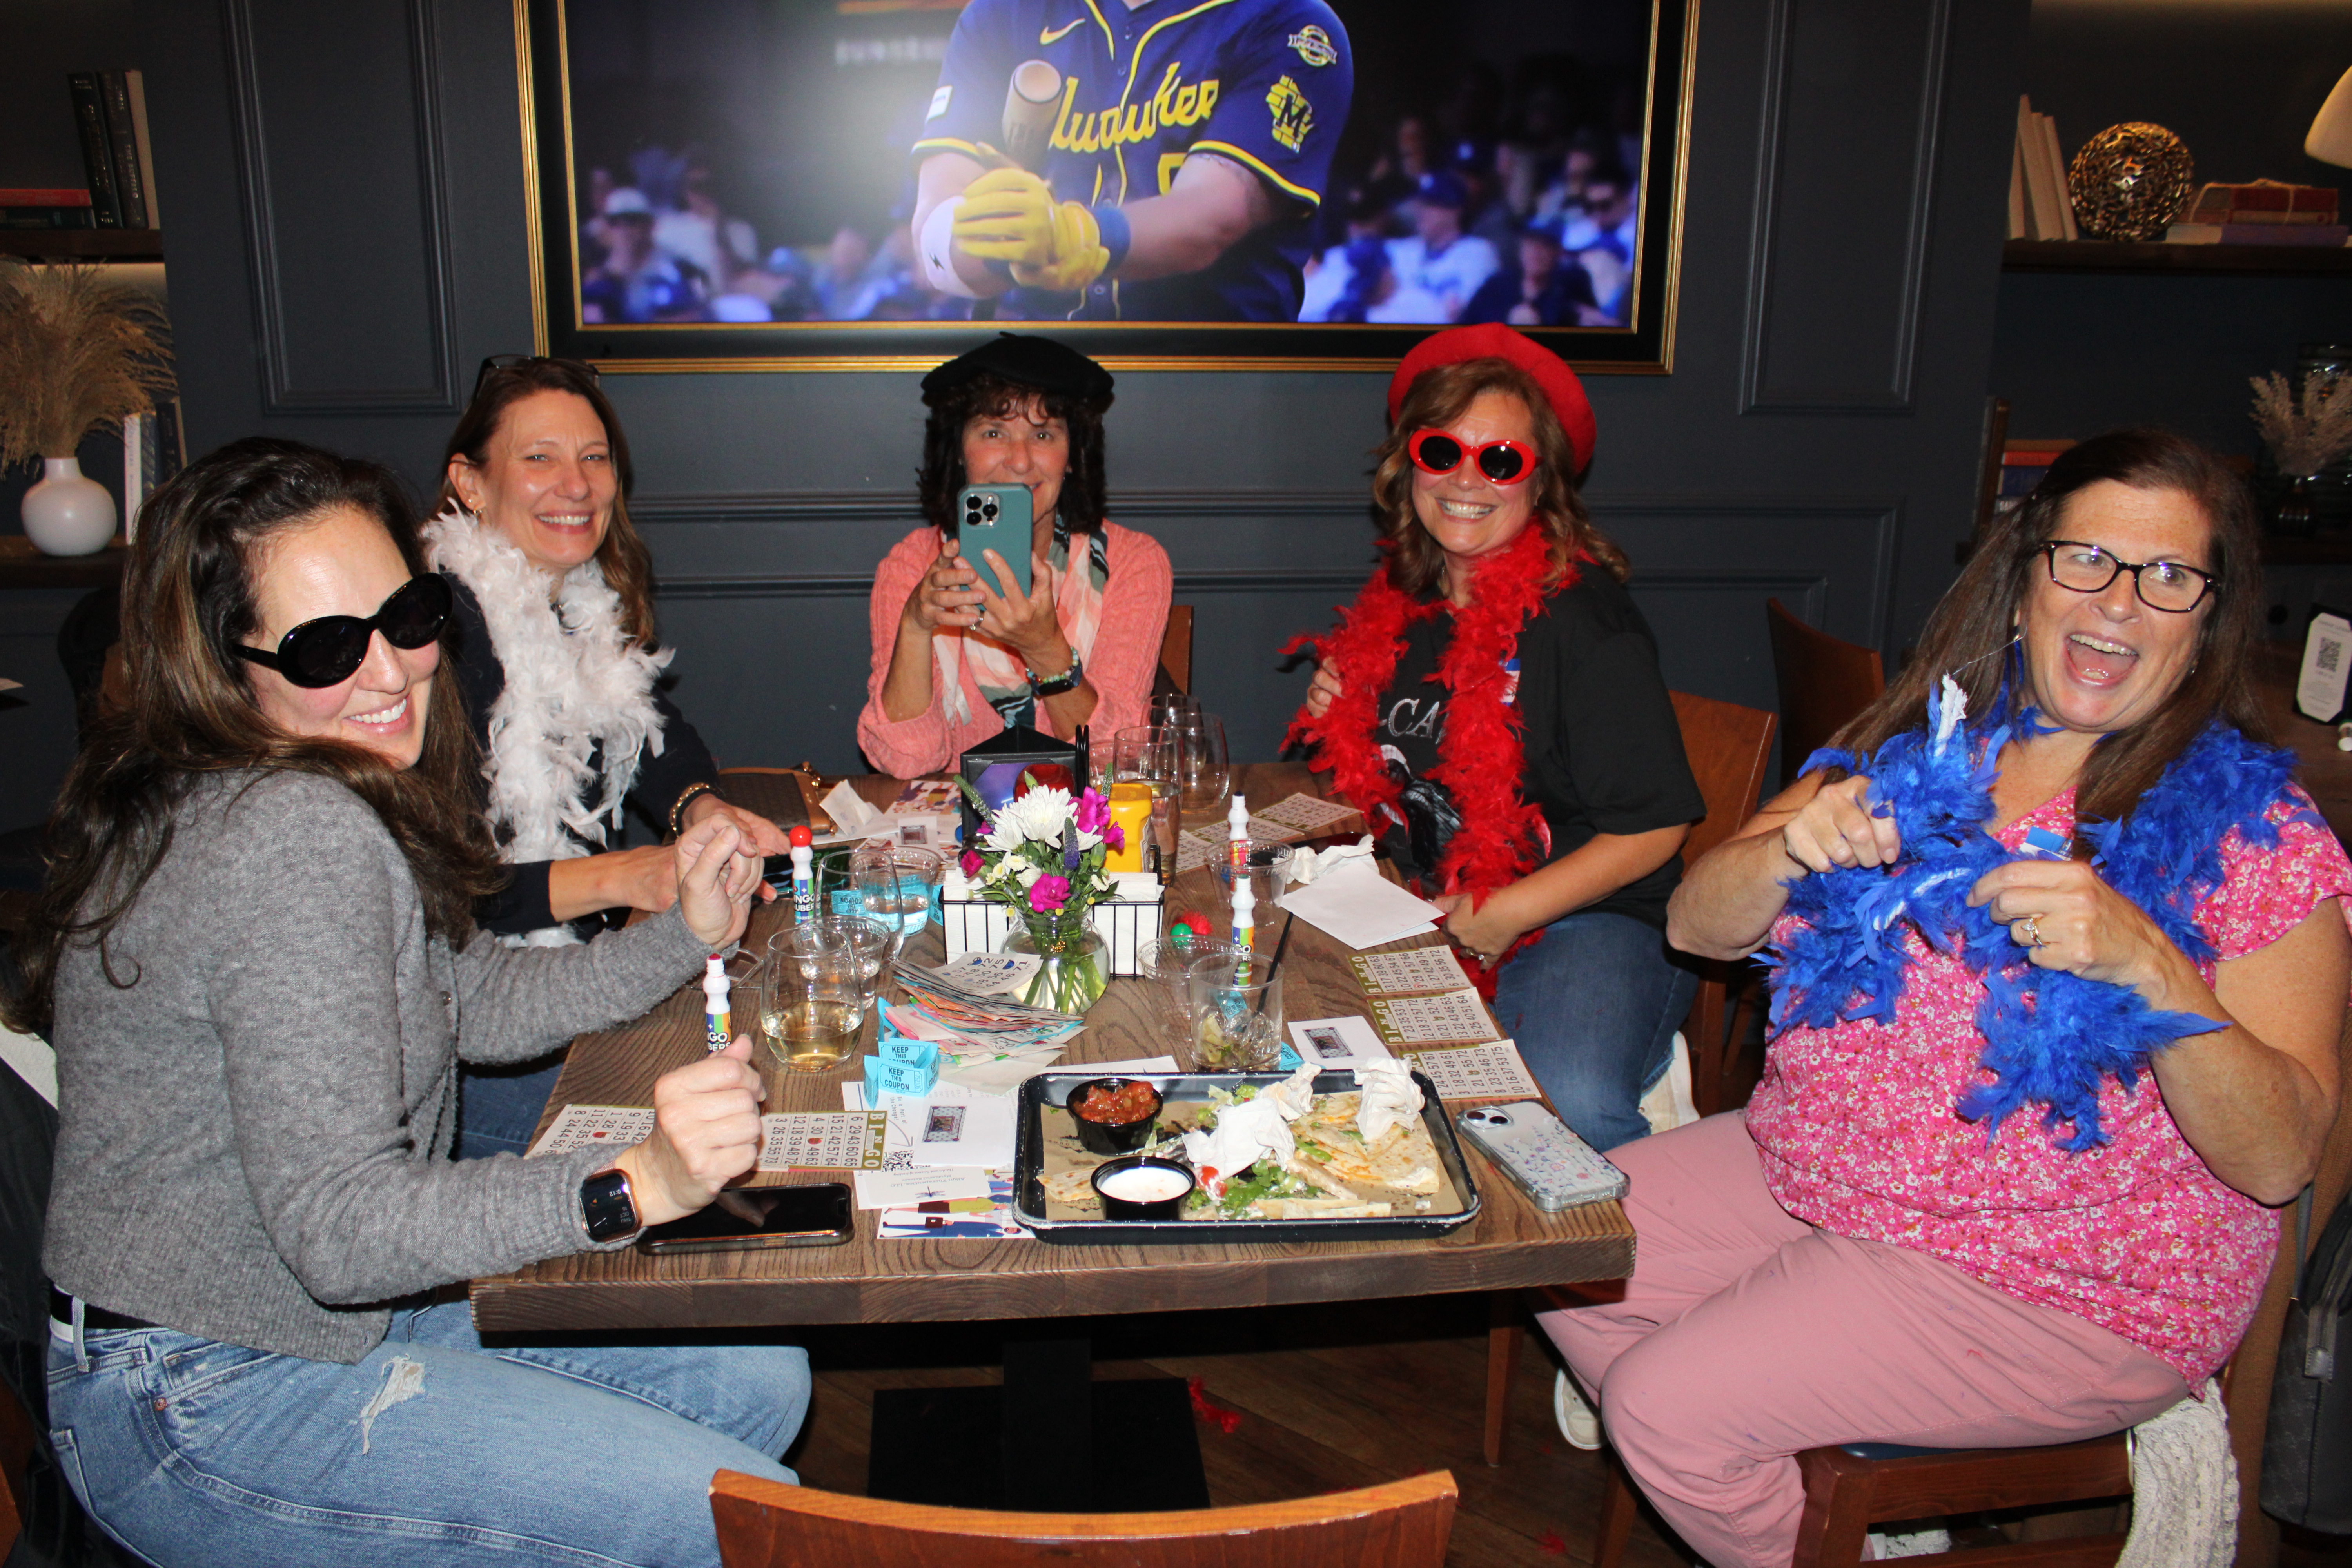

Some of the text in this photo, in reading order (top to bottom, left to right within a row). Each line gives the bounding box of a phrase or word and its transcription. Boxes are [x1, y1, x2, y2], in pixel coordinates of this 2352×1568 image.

[1049, 62, 1219, 153] lwaukee
[978, 958, 994, 968] 72
[990, 959, 1004, 969] 75
[1013, 960, 1028, 971] 71
[1456, 995, 1468, 1004] 64
[1491, 1047, 1504, 1055] 75
[889, 1067, 904, 1076] KEEP
[885, 1080, 909, 1091] COUPON
[558, 1129, 572, 1137] 44
[576, 1130, 591, 1138] 35
[613, 1132, 628, 1140] 33
[770, 1137, 783, 1145] 35
[789, 1137, 802, 1145] 39
[828, 1136, 841, 1145] 42
[848, 1136, 860, 1144] 43
[807, 1147, 819, 1156] 49
[827, 1147, 840, 1156] 57
[846, 1147, 858, 1156] 60
